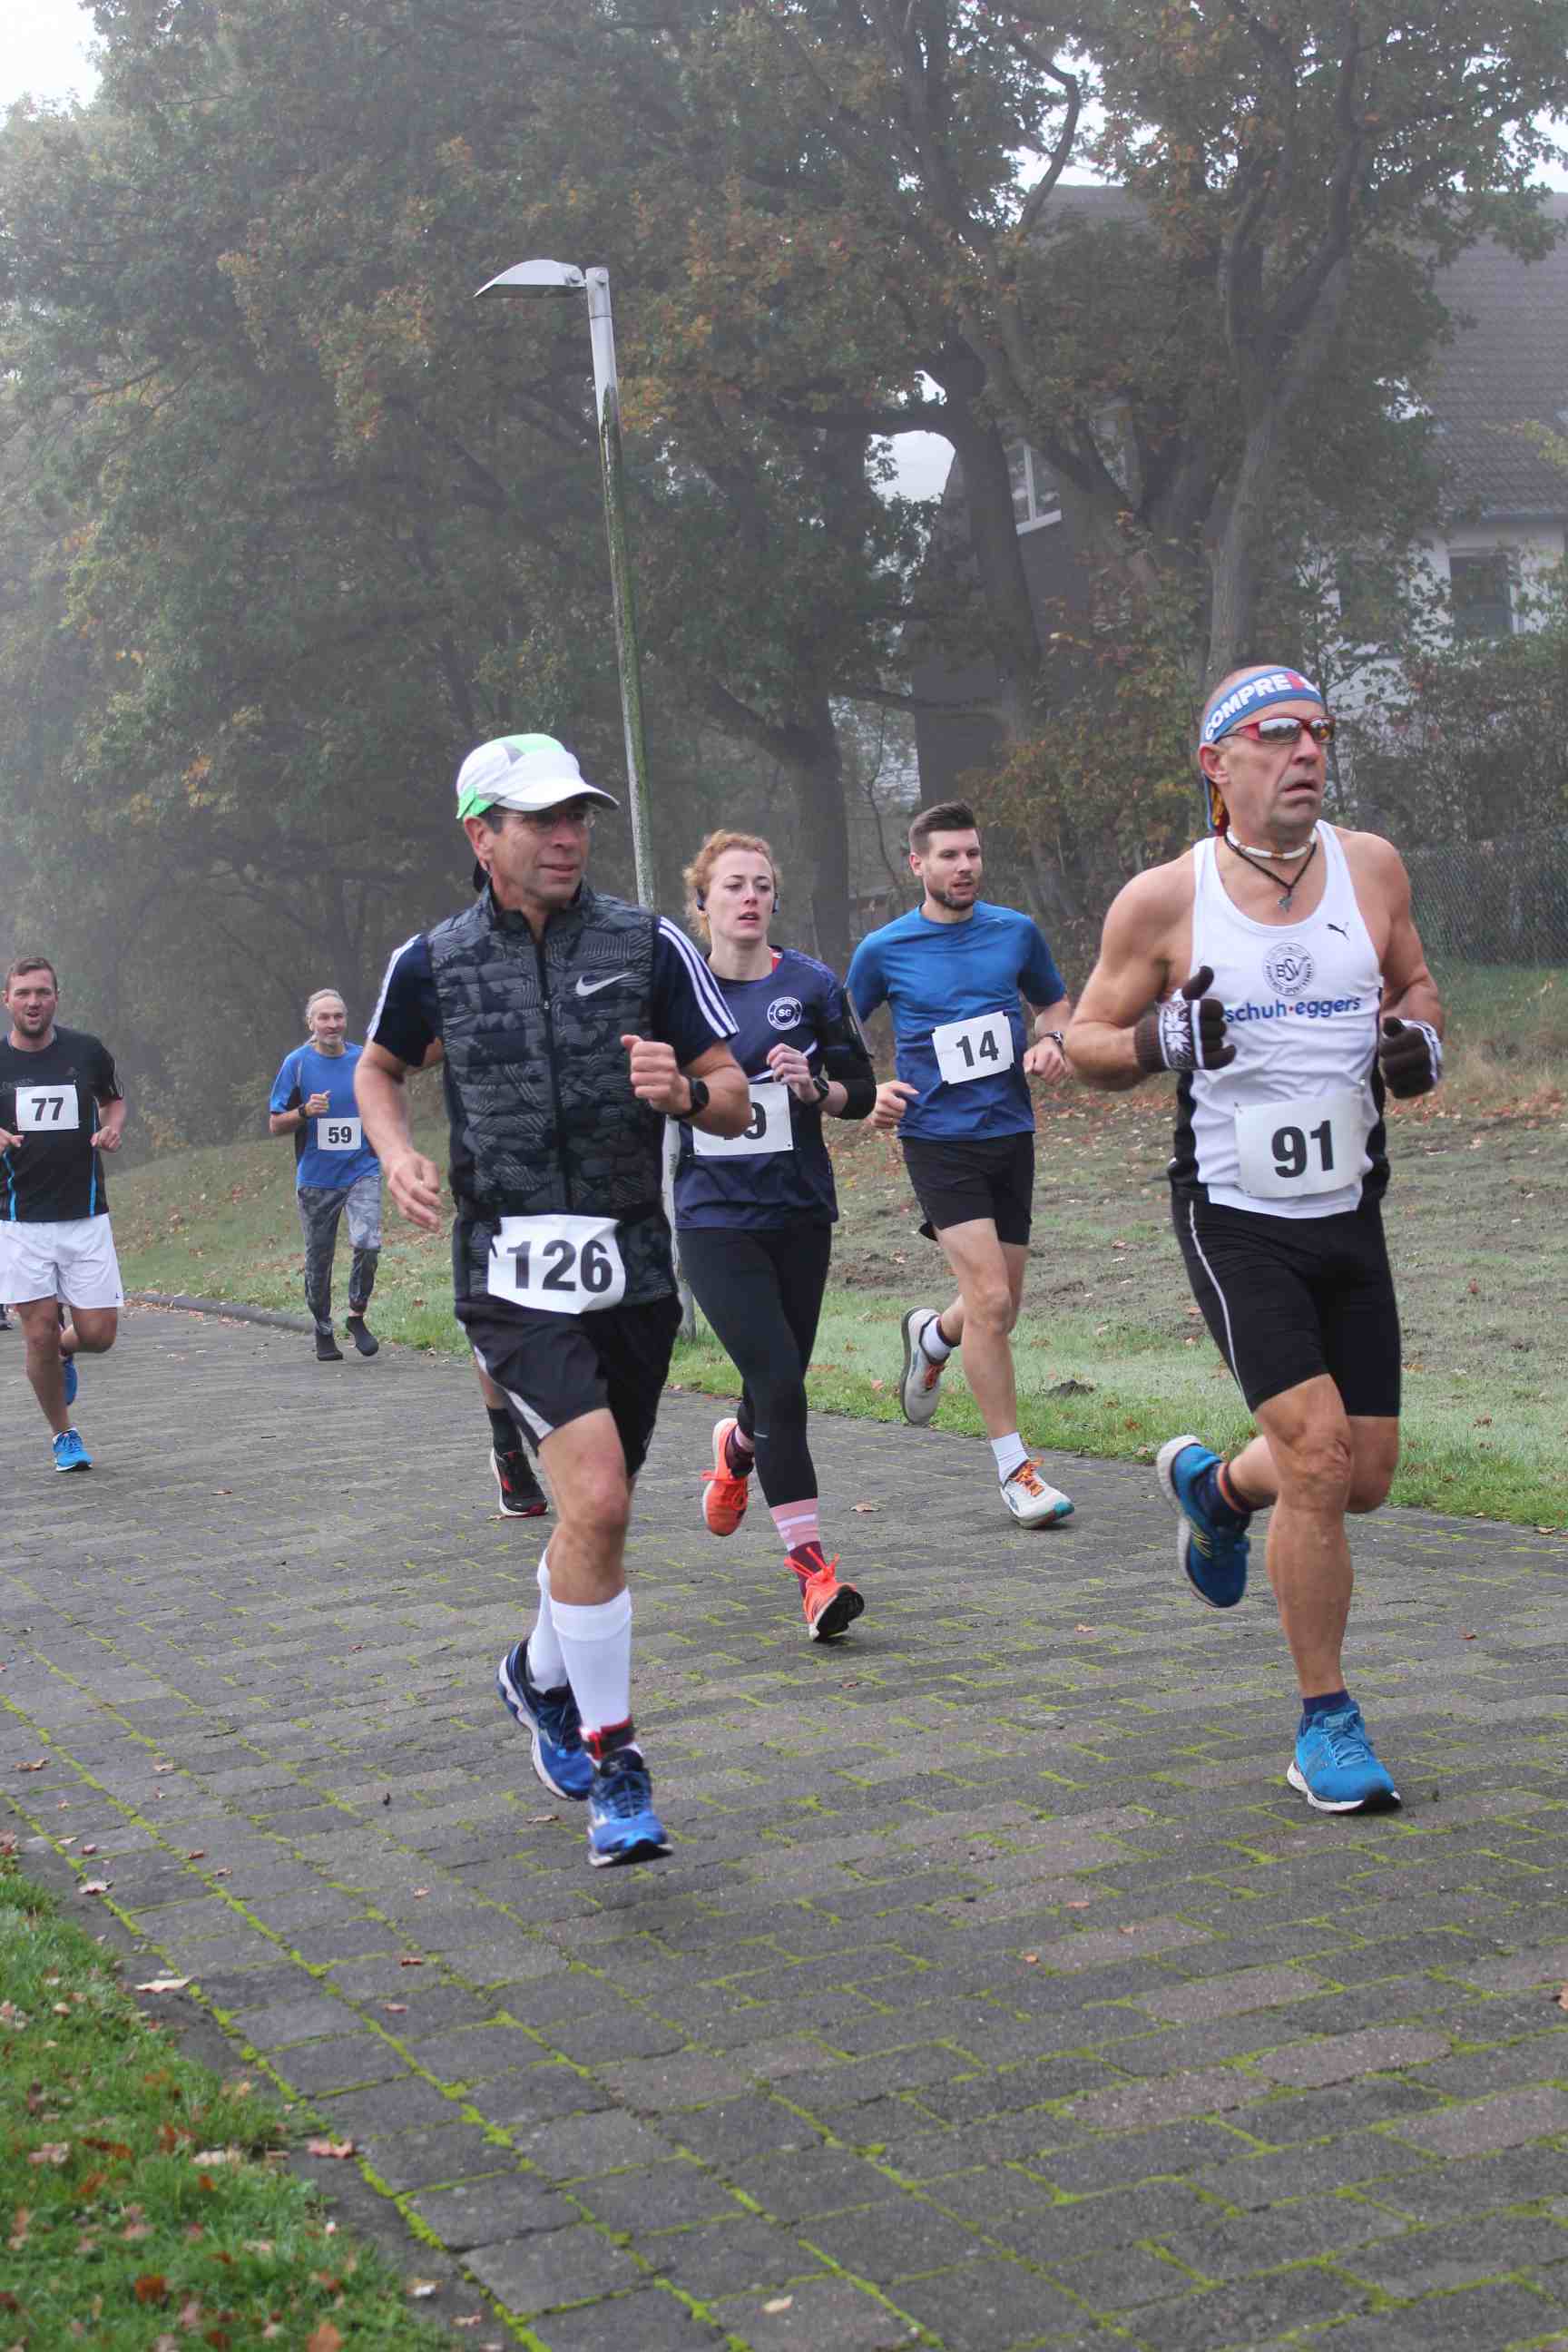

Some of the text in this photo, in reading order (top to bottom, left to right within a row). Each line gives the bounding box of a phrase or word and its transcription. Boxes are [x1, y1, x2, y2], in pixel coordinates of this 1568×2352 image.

[956, 1030, 999, 1067] 14
[31, 1096, 64, 1122] 77
[328, 1125, 352, 1144] 59
[1271, 1119, 1334, 1179] 91
[506, 1240, 613, 1294] 126
